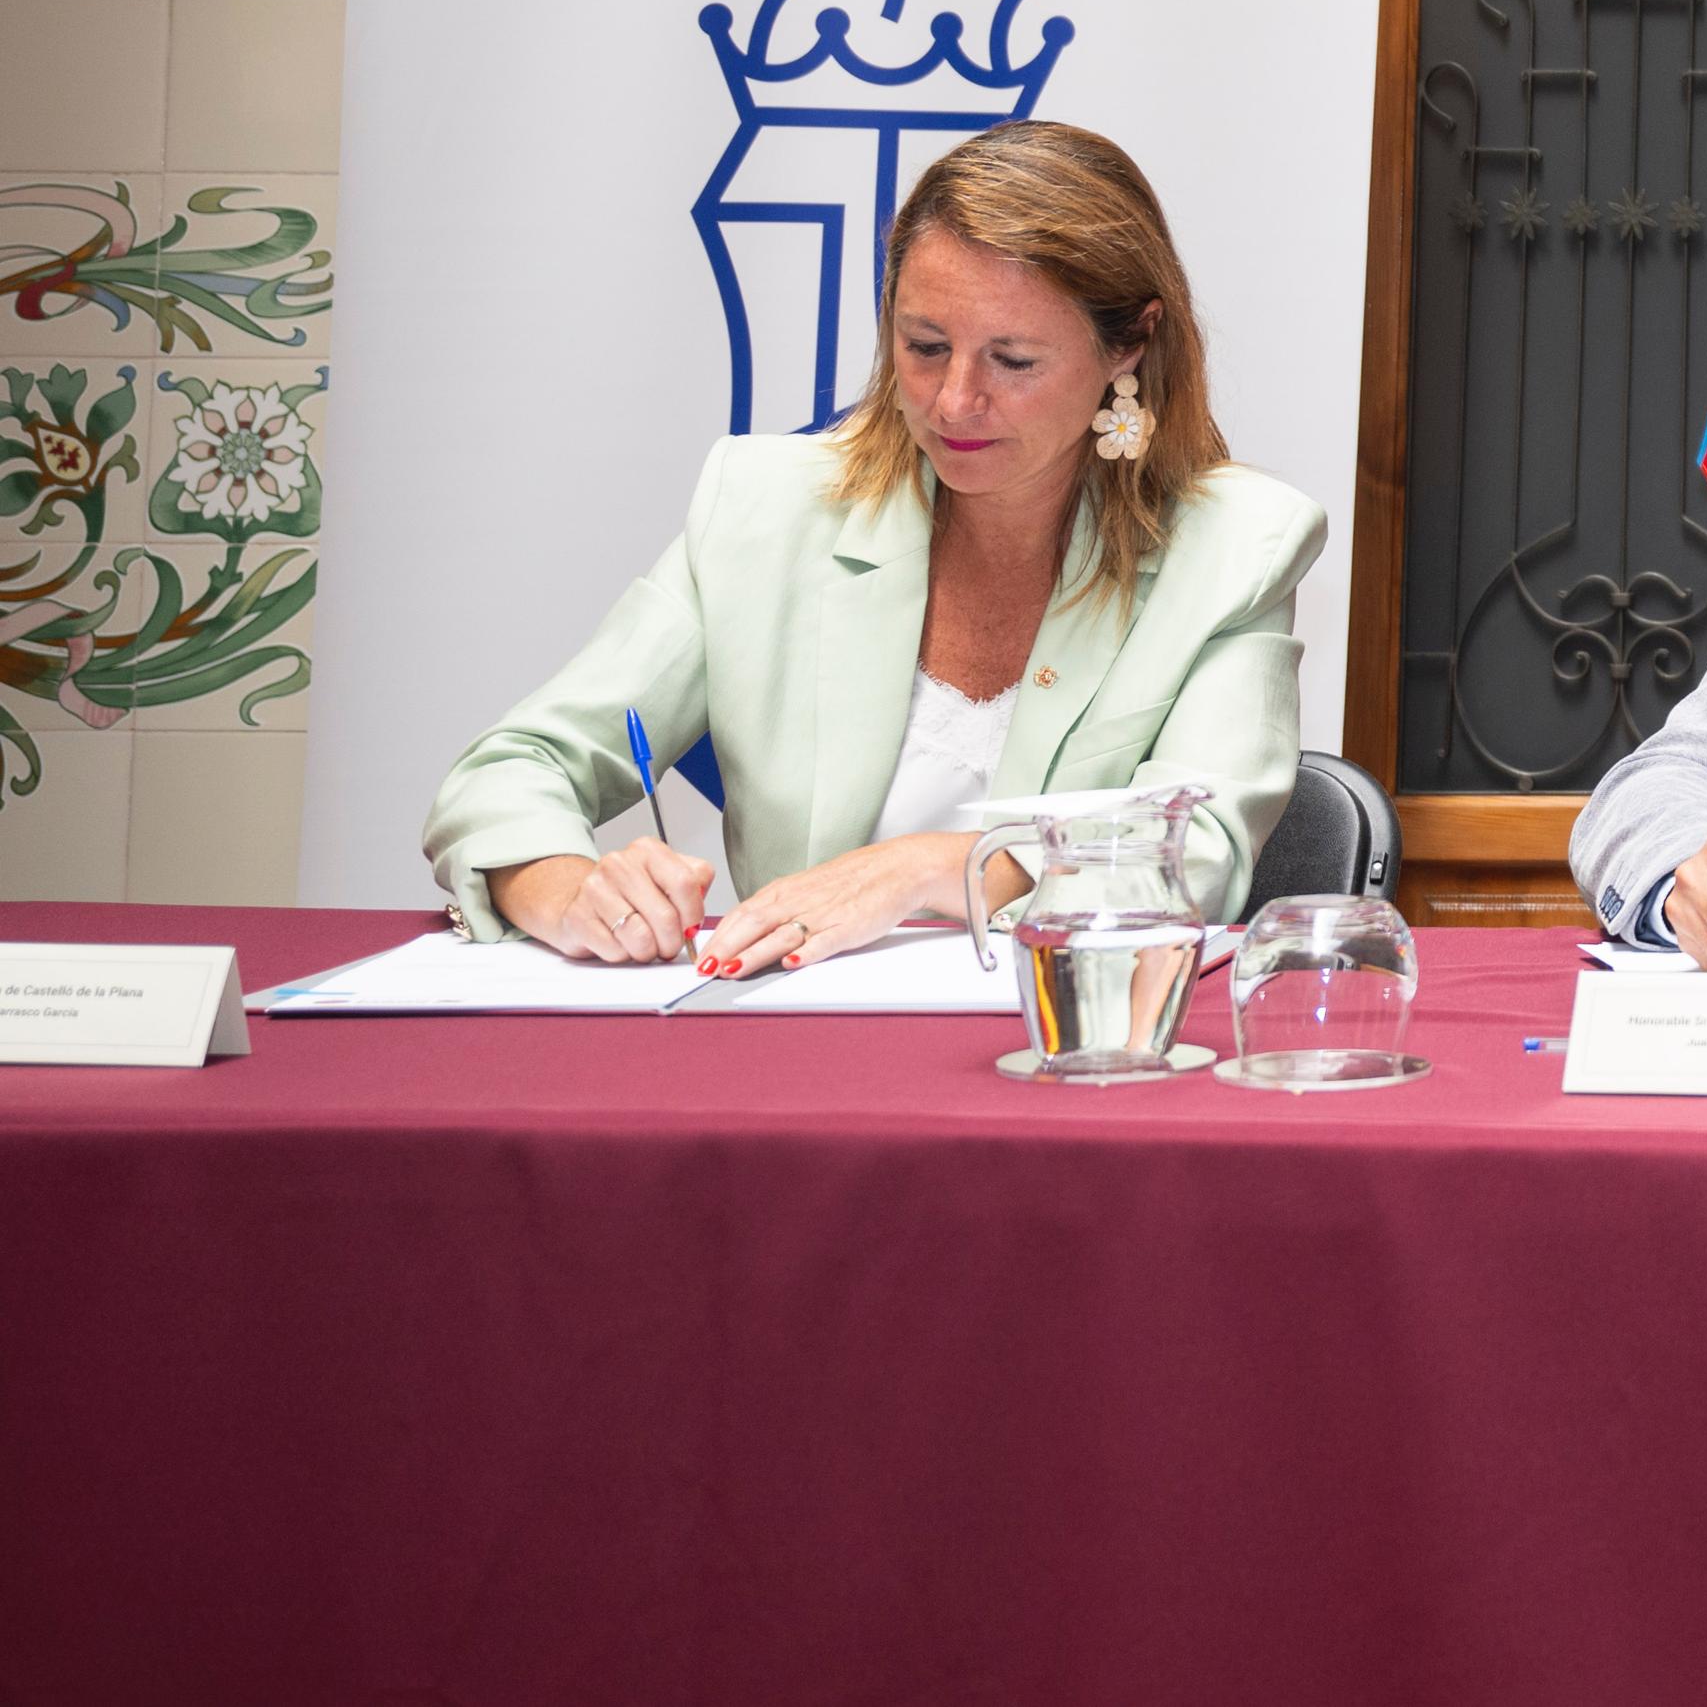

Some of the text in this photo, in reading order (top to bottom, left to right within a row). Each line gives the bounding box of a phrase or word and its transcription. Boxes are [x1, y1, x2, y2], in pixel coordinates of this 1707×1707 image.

[5, 985, 20, 996] de
[76, 985, 92, 997] de
[94, 986, 105, 997] la
[109, 986, 144, 998] Plana
[0, 1008, 40, 1017] arrasco
